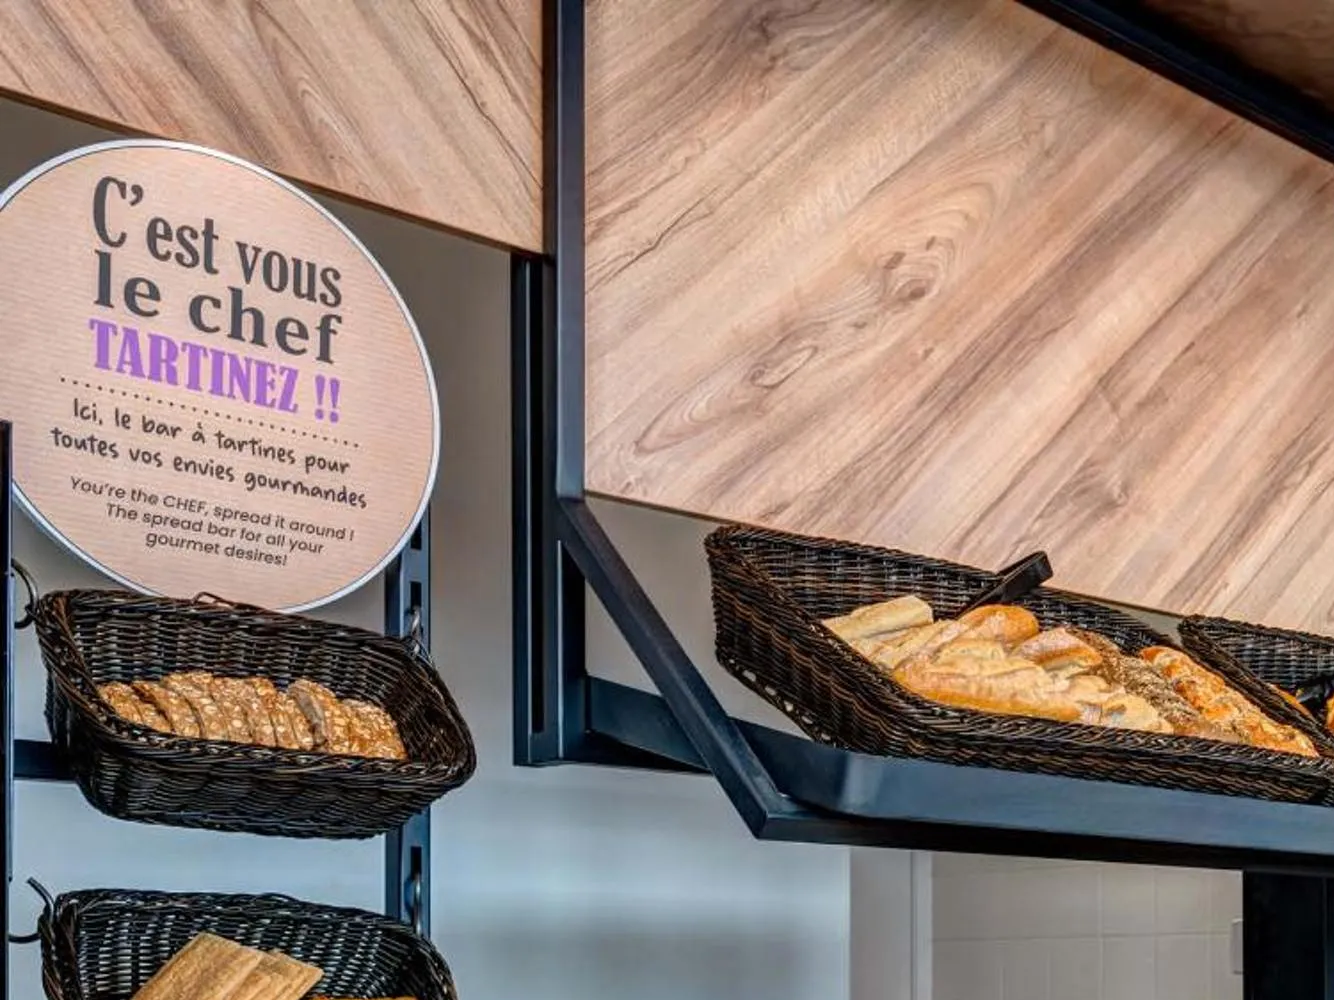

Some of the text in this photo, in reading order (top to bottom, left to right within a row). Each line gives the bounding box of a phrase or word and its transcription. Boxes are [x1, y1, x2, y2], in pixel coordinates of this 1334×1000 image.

[93, 176, 342, 307] C’est vous
[94, 249, 342, 364] le chef
[89, 318, 340, 423] TARTINEZ !!
[50, 427, 368, 509] toutes vos envies gourmandes
[114, 407, 132, 430] le
[141, 408, 182, 438] bar
[191, 421, 206, 444] à
[215, 429, 297, 465] tartines
[304, 455, 350, 475] pour
[106, 502, 325, 557] The spread bar for all your
[130, 488, 159, 505] the
[162, 494, 209, 517] CHEF,
[212, 503, 271, 527] spread
[274, 513, 286, 529] it
[288, 519, 346, 540] around
[145, 531, 288, 567] gourmet desires!
